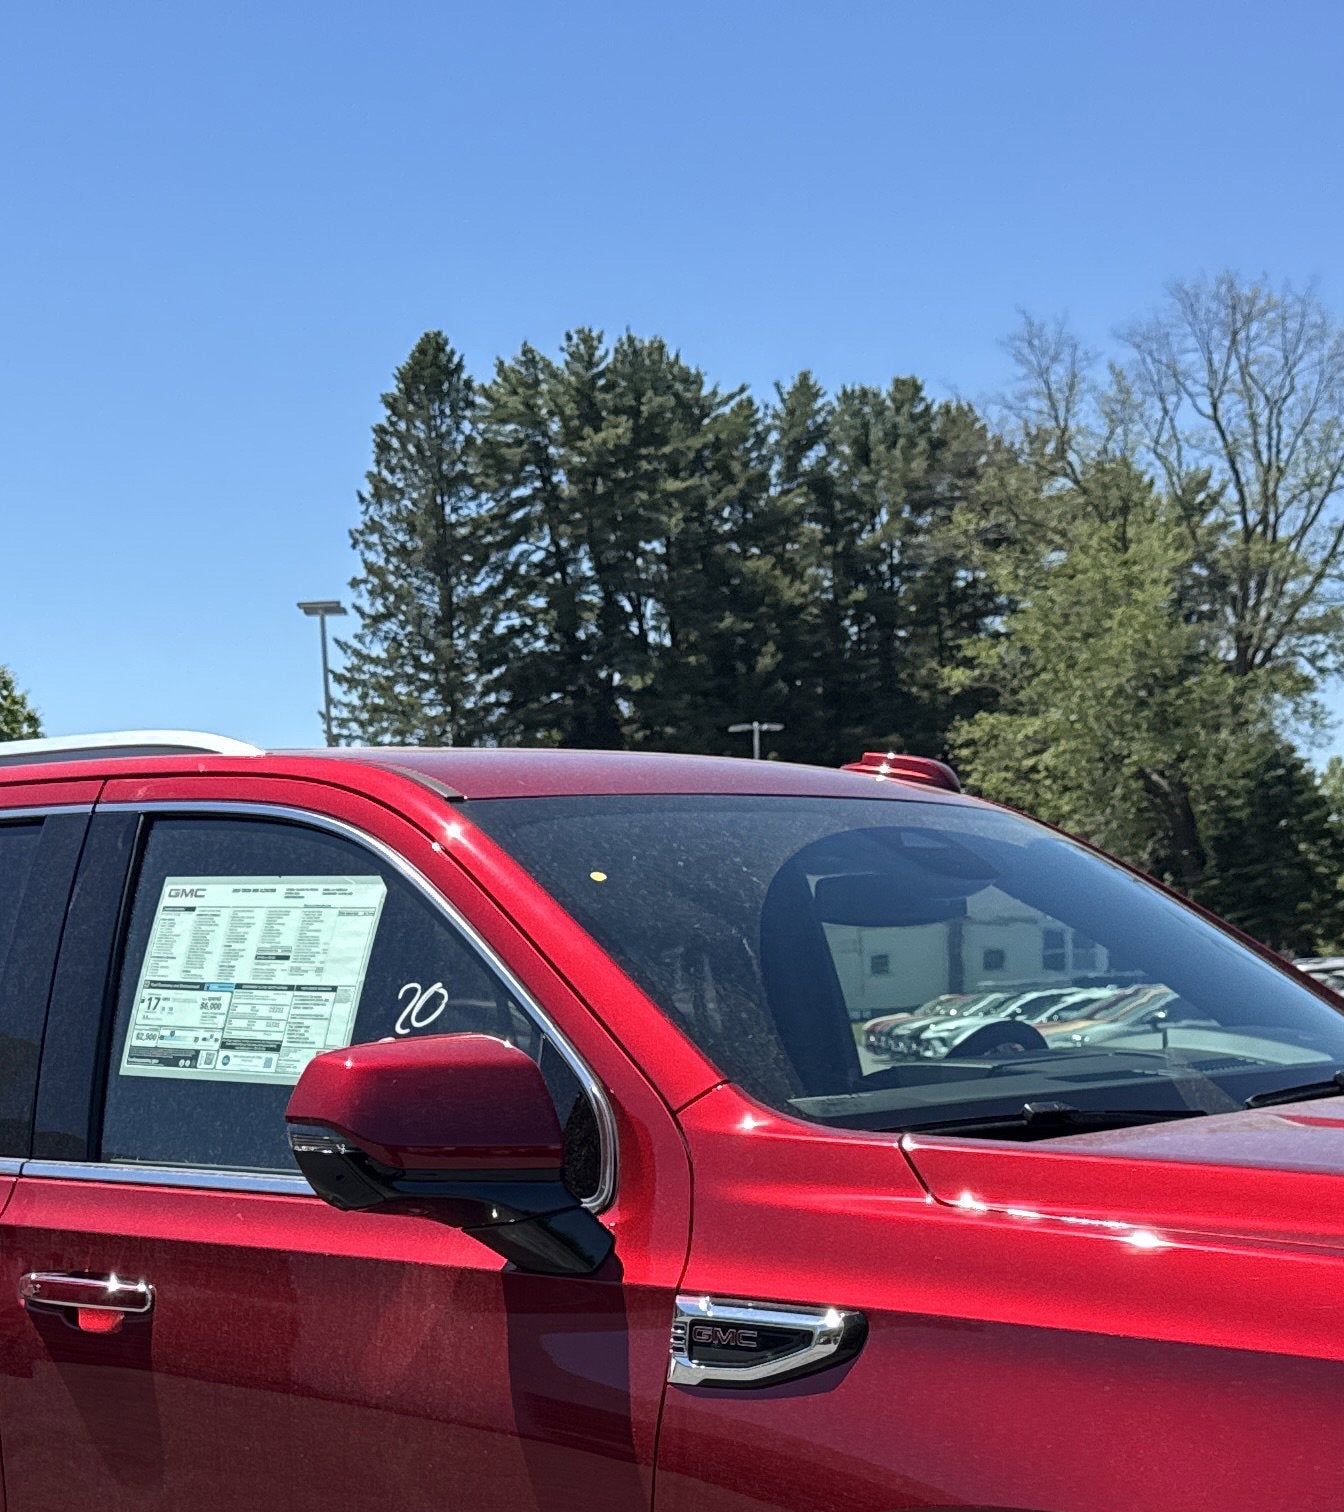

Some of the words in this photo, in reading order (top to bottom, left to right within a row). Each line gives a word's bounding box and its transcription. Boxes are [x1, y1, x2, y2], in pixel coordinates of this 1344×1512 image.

[167, 888, 207, 898] GMC
[147, 997, 161, 1010] 17
[395, 982, 449, 1034] 20
[691, 1325, 758, 1348] GMC
